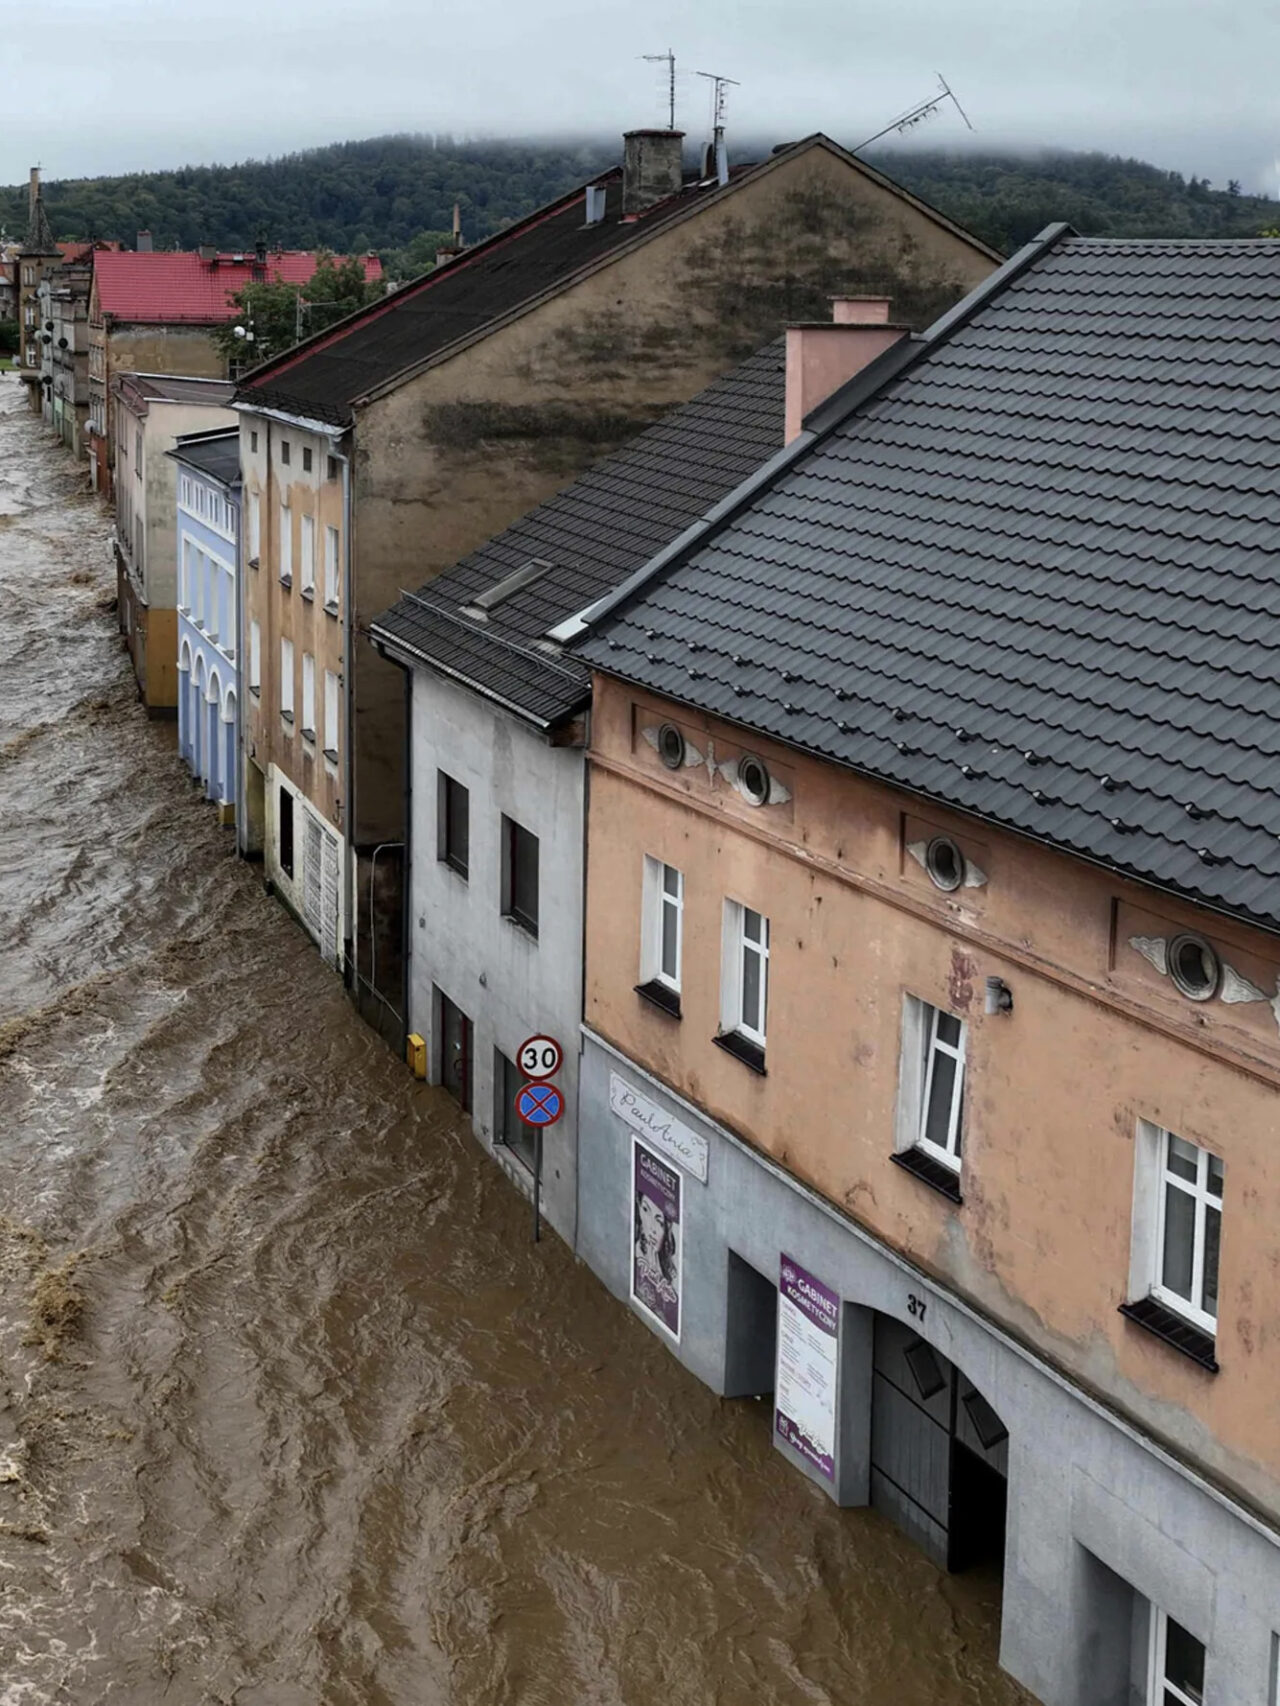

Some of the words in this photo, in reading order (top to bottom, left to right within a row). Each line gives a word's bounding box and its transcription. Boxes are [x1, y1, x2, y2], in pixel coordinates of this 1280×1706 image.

[524, 1048, 556, 1070] 30
[640, 1153, 676, 1191] GABINET
[787, 1286, 837, 1330] KOSMETYCZNY
[798, 1279, 837, 1318] GABINET
[907, 1294, 927, 1322] 37
